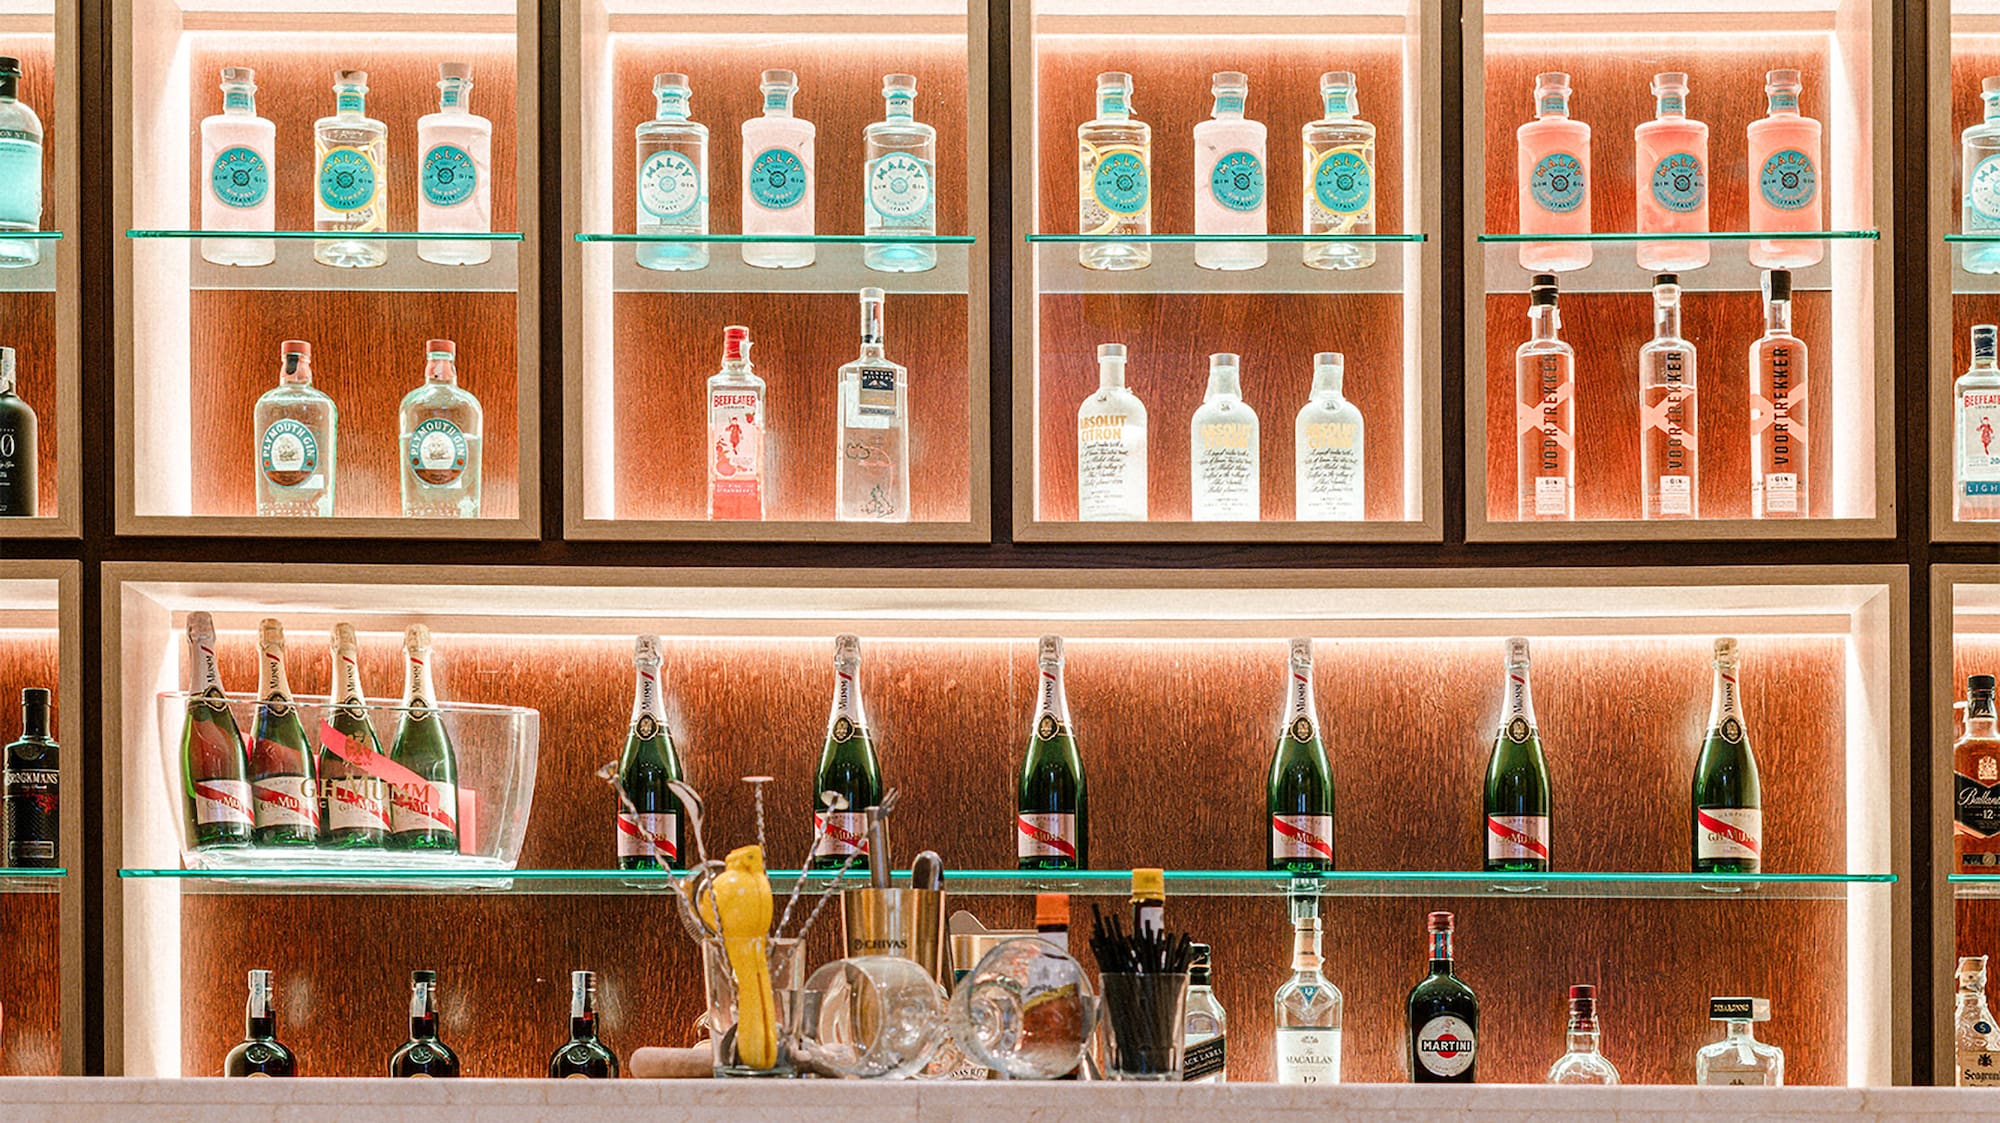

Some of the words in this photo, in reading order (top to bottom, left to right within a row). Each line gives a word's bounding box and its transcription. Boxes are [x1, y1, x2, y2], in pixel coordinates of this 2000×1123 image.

[218, 151, 264, 171] MALFY
[324, 154, 369, 174] MALFY
[425, 150, 470, 170] MALFY
[645, 157, 693, 178] MALFY
[754, 153, 801, 173] MALFY
[876, 160, 924, 180] MALFY
[1100, 156, 1145, 176] MALFY
[1217, 156, 1262, 174] MALFY
[1322, 156, 1366, 175] MALFY
[1536, 156, 1582, 177] MALFY
[1658, 157, 1703, 177] MALFY
[1766, 153, 1812, 174] MALFY
[713, 395, 757, 407] BEEFEATER
[1667, 352, 1683, 469] VOORTREKKER
[1773, 348, 1789, 465] VOORTREKKER
[1543, 354, 1558, 469] VOORTREKKER
[263, 423, 304, 457] PLYMOUTH
[302, 437, 315, 457] GIN
[410, 421, 456, 455] PLYMOUTH
[452, 436, 465, 457] GIN
[1082, 428, 1121, 442] CITRON
[8, 771, 58, 785] BROCKMANS
[1983, 809, 1994, 820] 12
[865, 940, 907, 949] CHIVAS
[1304, 987, 1315, 997] 12
[1200, 1047, 1223, 1062] LABEL
[1423, 1041, 1471, 1051] MARTINI
[1286, 1056, 1333, 1065] MACALLAN
